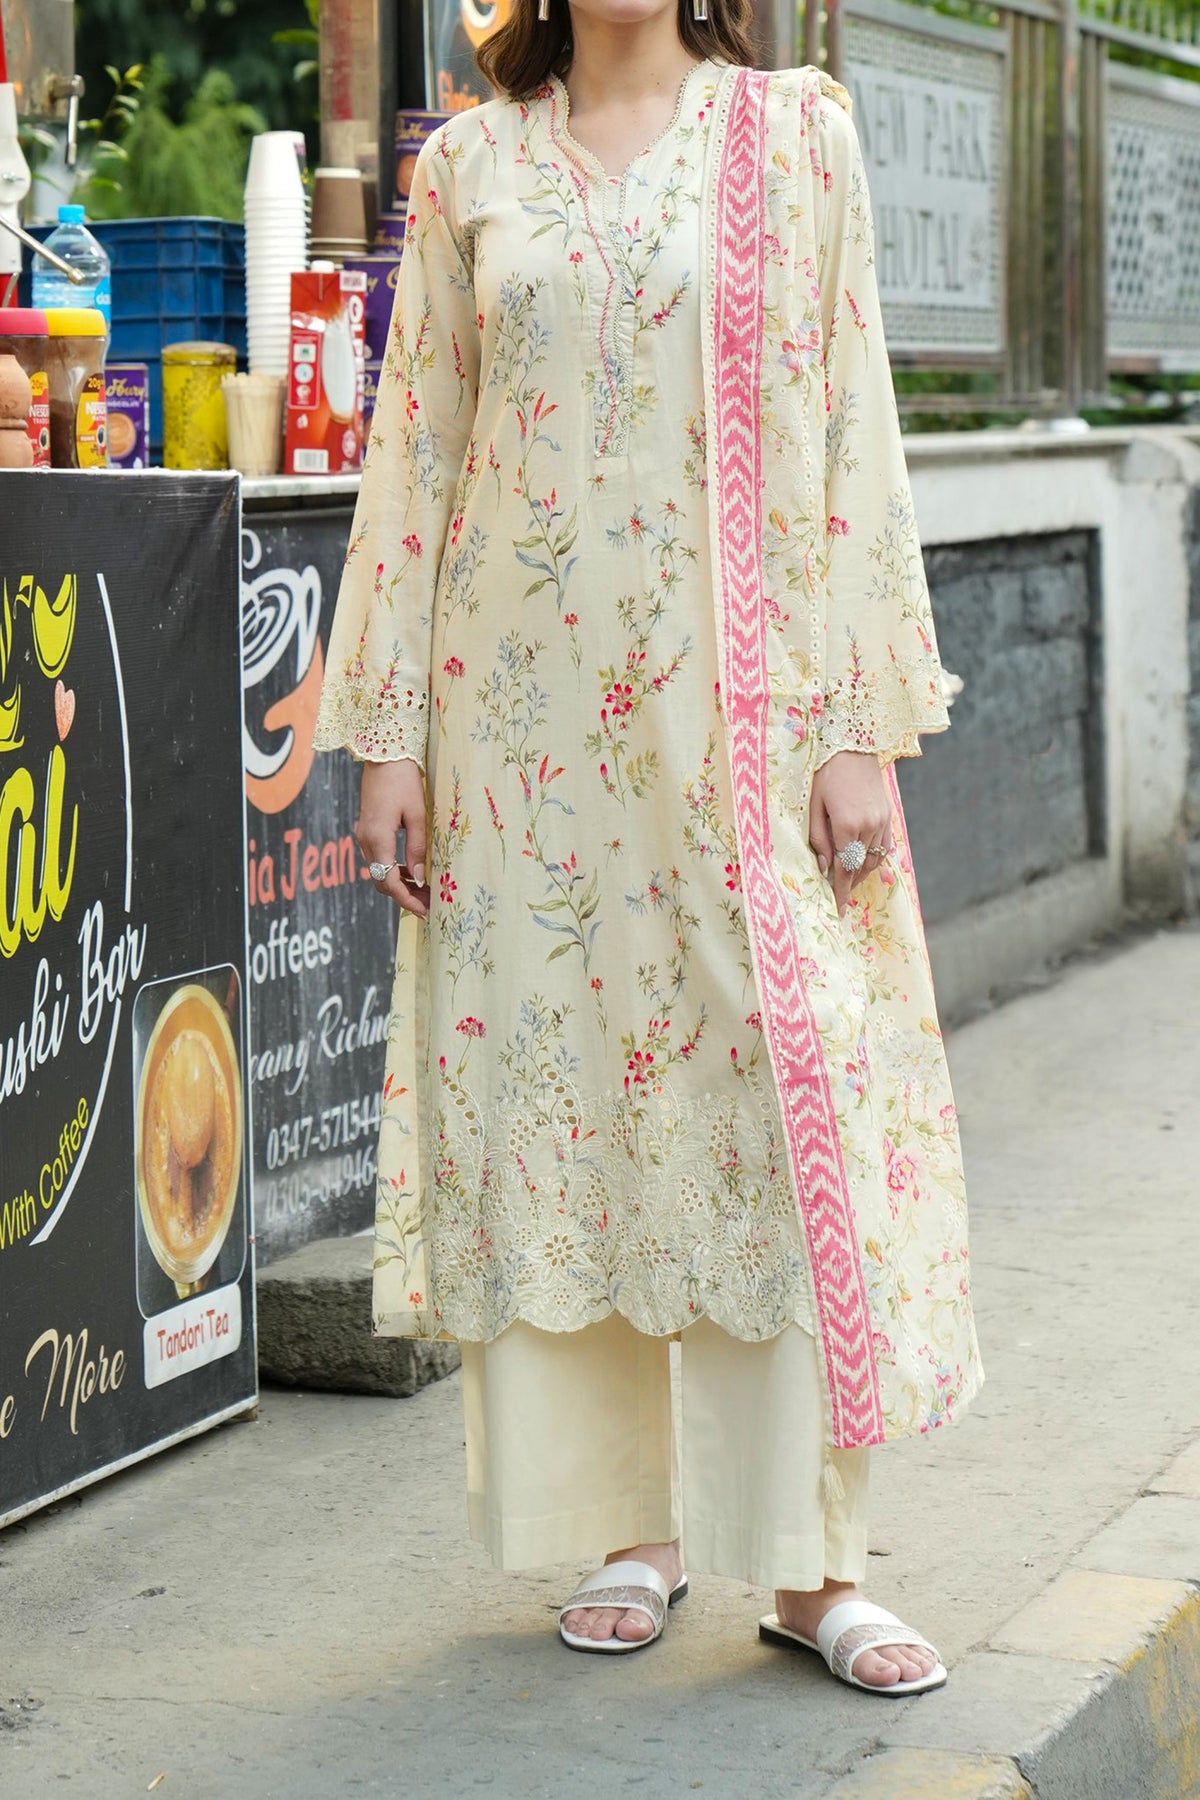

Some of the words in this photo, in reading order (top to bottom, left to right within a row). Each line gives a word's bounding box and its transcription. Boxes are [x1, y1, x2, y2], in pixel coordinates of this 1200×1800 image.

[924, 94, 987, 182] PARK
[78, 900, 147, 1044] Bar
[247, 917, 333, 984] offees
[0, 1189, 37, 1249] With
[39, 1097, 89, 1209] Coffee
[24, 1328, 127, 1435] More
[157, 1314, 204, 1361] Tandori
[206, 1309, 229, 1340] Tea
